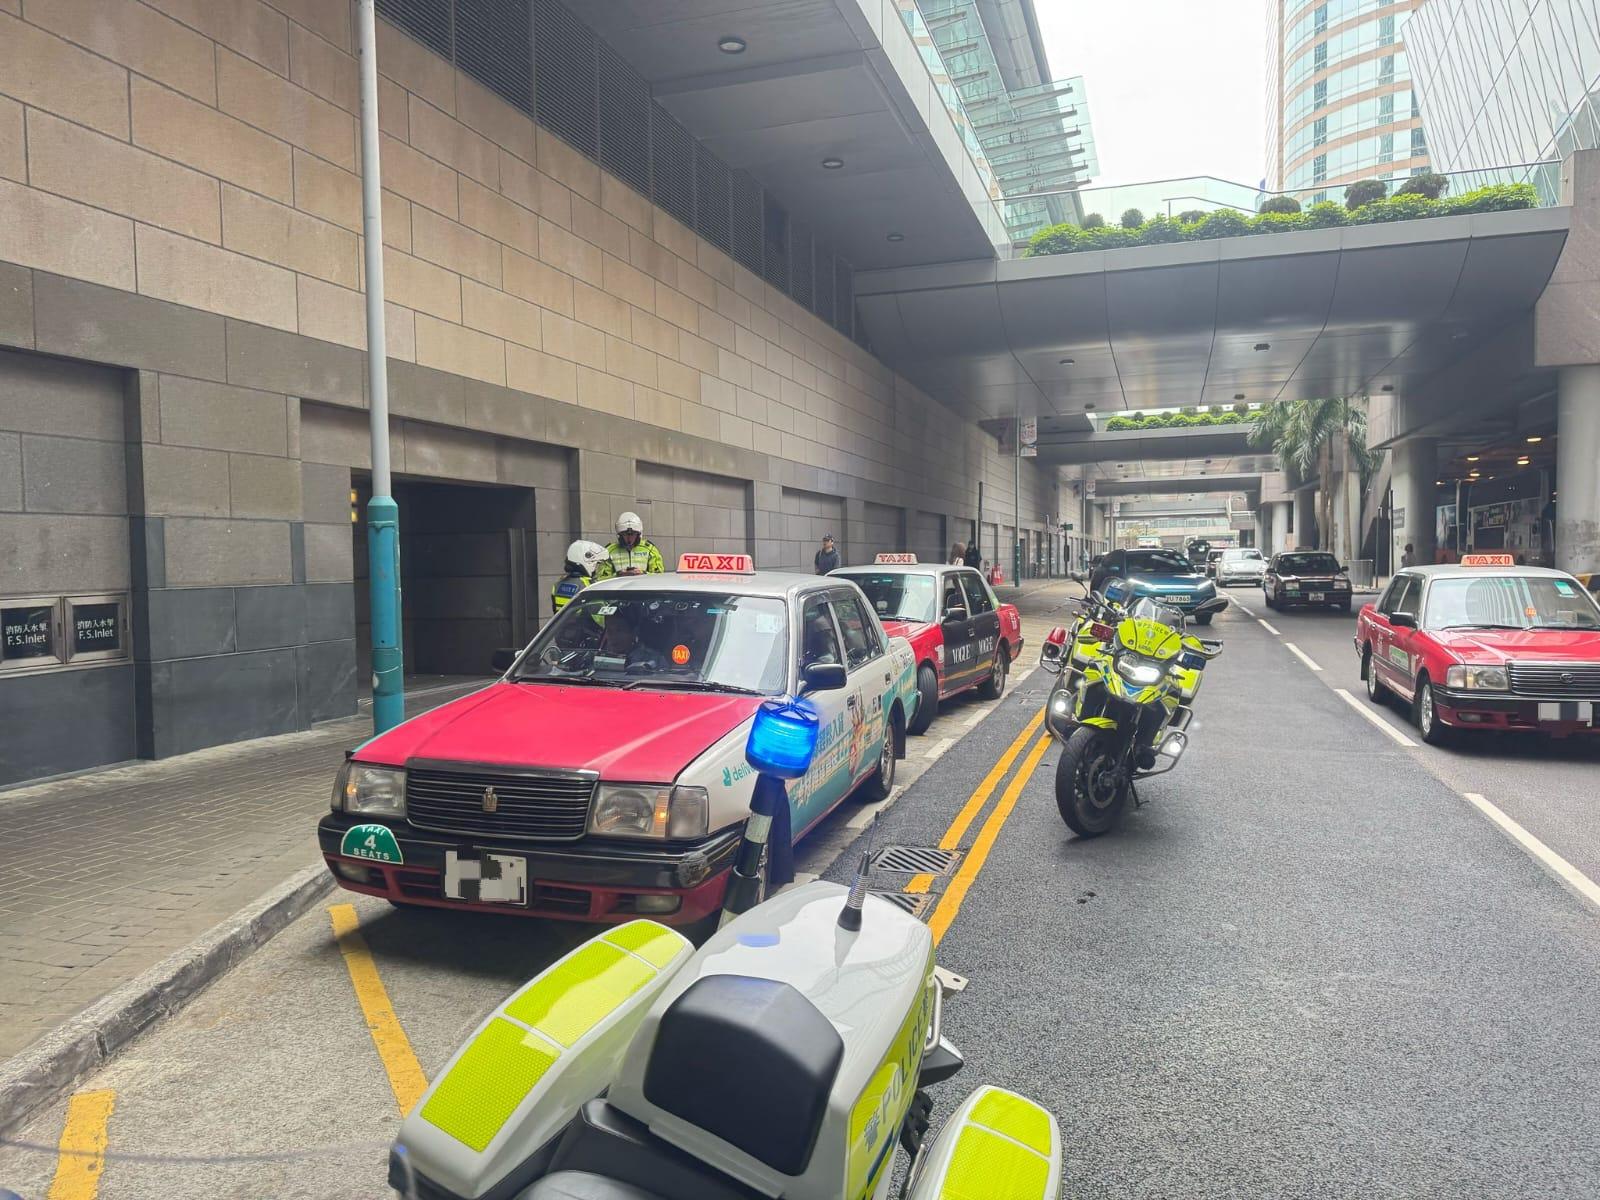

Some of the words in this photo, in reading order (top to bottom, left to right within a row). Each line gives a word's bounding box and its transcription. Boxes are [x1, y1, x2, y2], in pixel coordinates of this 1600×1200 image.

[684, 555, 745, 571] TAXI
[879, 554, 912, 562] TAXI
[1466, 556, 1511, 565] TAXI
[672, 650, 689, 660] TAXI
[733, 762, 754, 781] deliv
[360, 826, 386, 836] TAXI
[364, 834, 376, 850] 4
[353, 847, 390, 860] SEATS
[882, 1006, 923, 1124] POLICE
